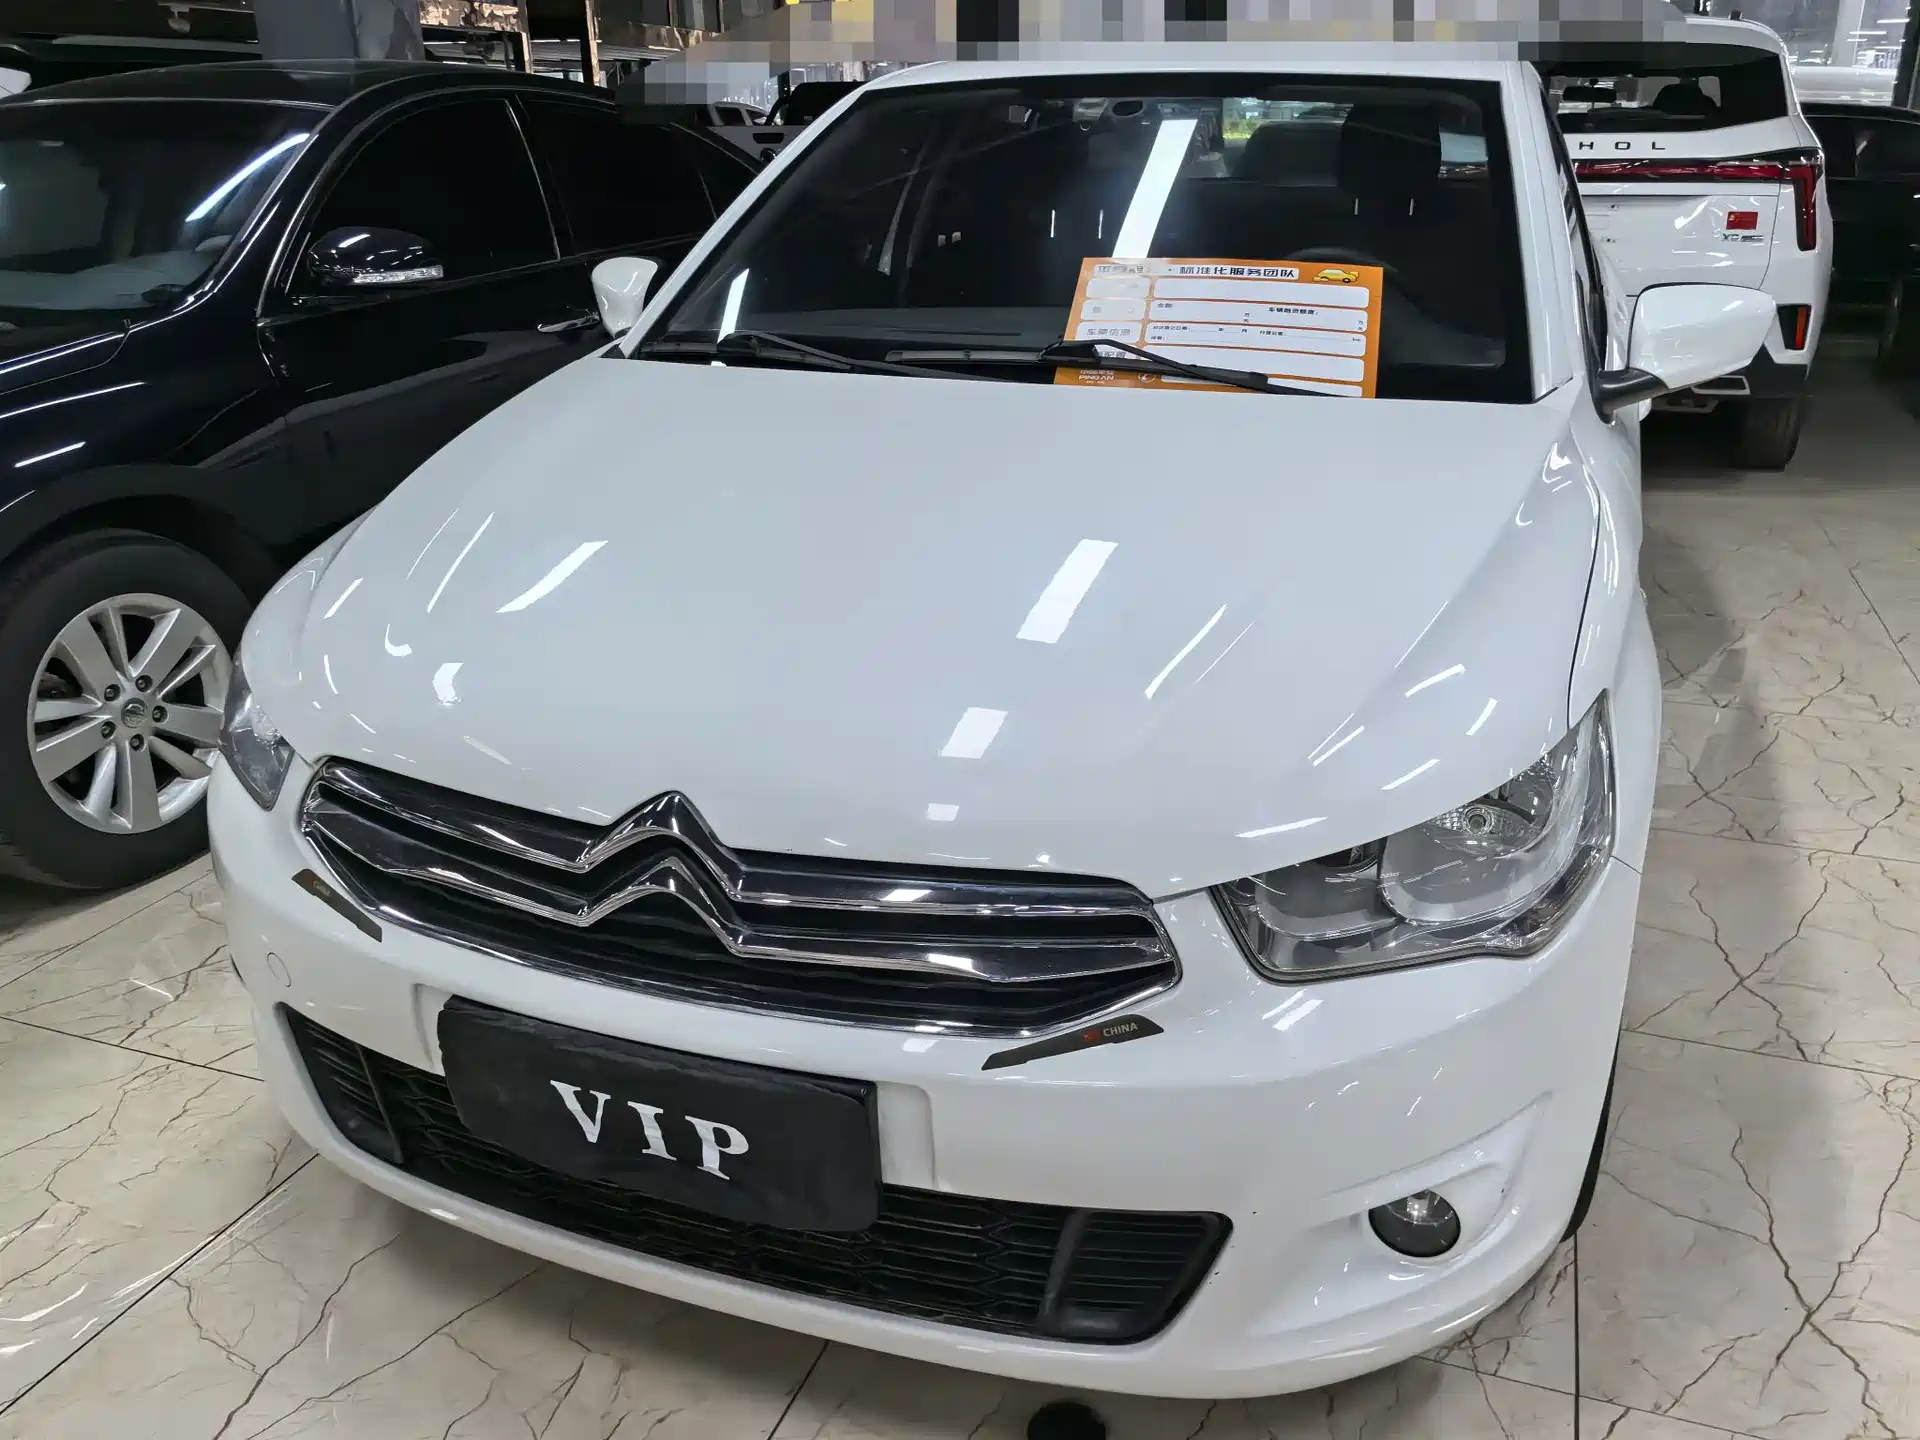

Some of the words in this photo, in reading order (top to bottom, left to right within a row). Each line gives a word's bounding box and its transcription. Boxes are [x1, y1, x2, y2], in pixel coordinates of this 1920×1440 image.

[1179, 266, 1295, 278] 标准化服务团队
[1103, 1021, 1139, 1037] CHINA
[550, 1079, 749, 1180] VIP
